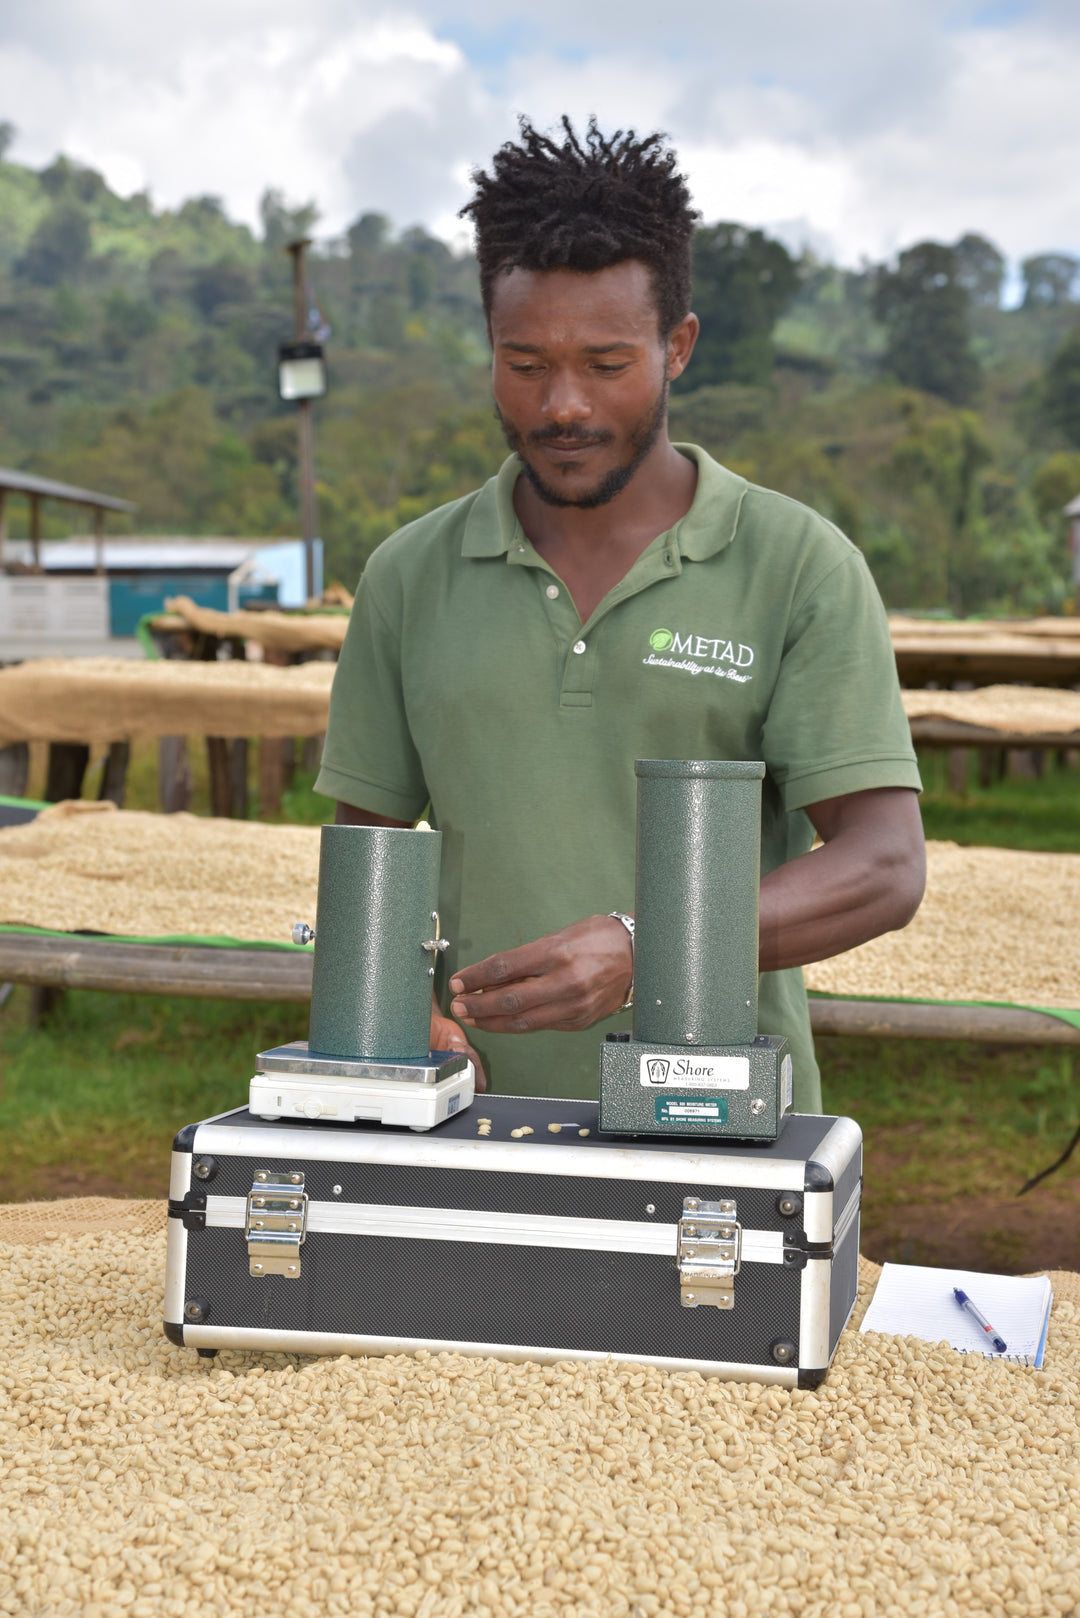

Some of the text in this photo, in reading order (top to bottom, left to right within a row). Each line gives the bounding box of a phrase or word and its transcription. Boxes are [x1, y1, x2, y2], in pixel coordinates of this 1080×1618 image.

[670, 632, 754, 667] METAD
[643, 654, 703, 675] Sustainability
[726, 669, 752, 683] Best
[673, 1059, 714, 1076] Shore
